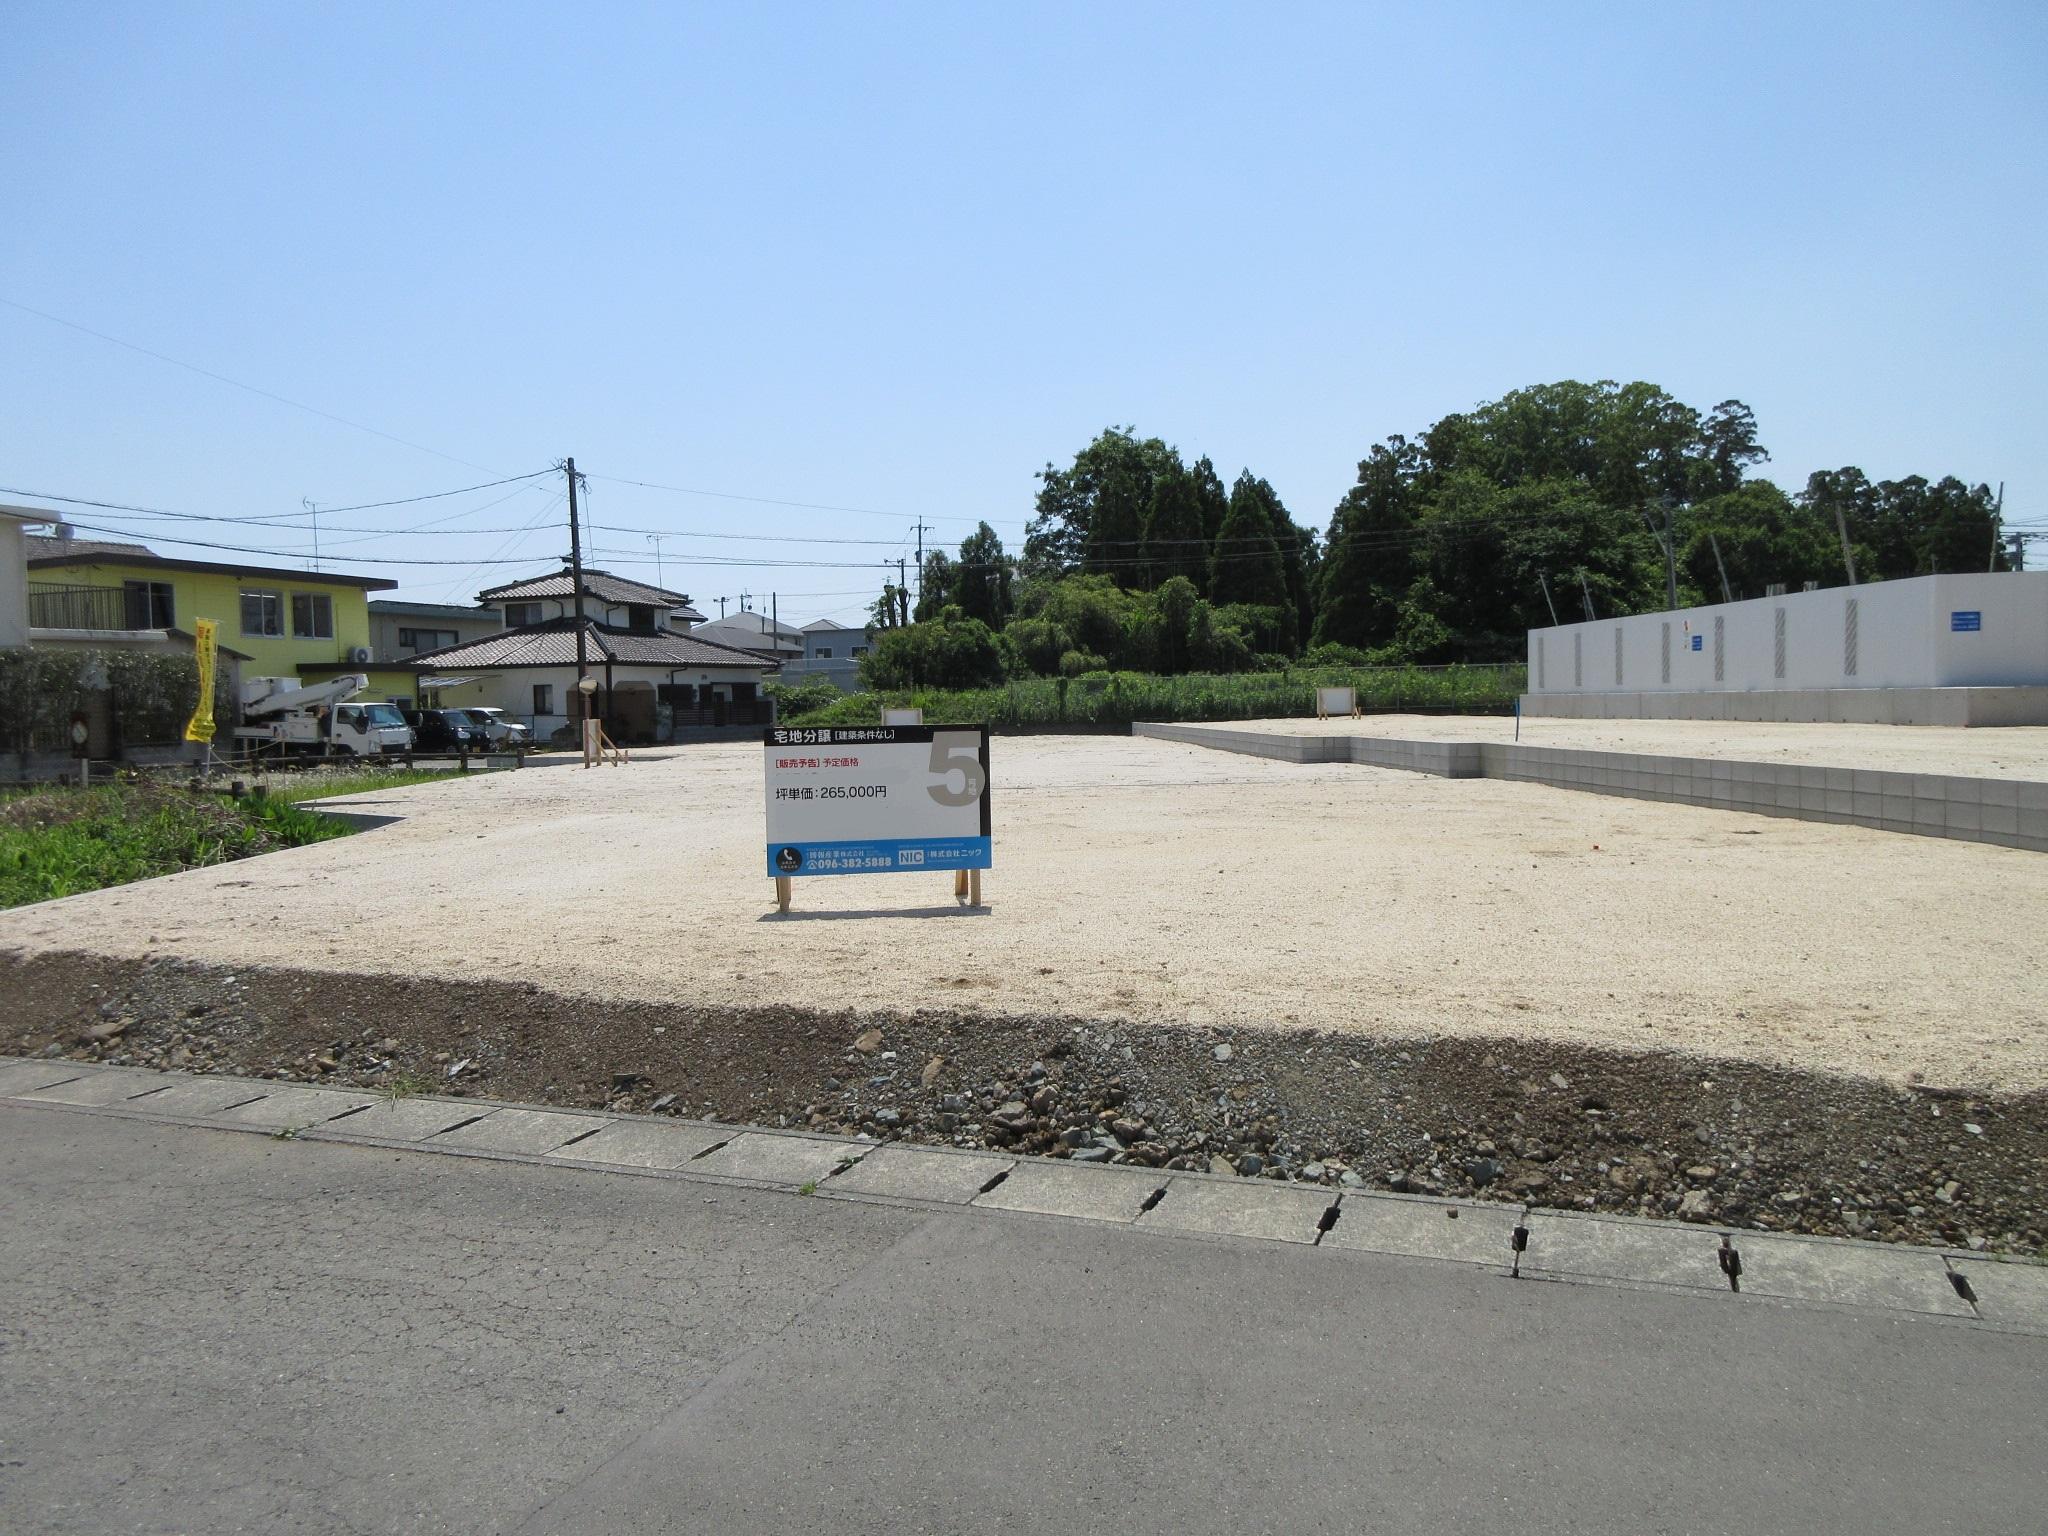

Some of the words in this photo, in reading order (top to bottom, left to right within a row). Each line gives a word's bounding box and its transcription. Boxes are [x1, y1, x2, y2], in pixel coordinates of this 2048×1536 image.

[774, 729, 832, 743] 宅地分譲
[823, 757, 859, 768] 予定価格
[927, 731, 985, 807] 5
[818, 856, 892, 869] 096-382-5888
[900, 851, 923, 863] NIC
